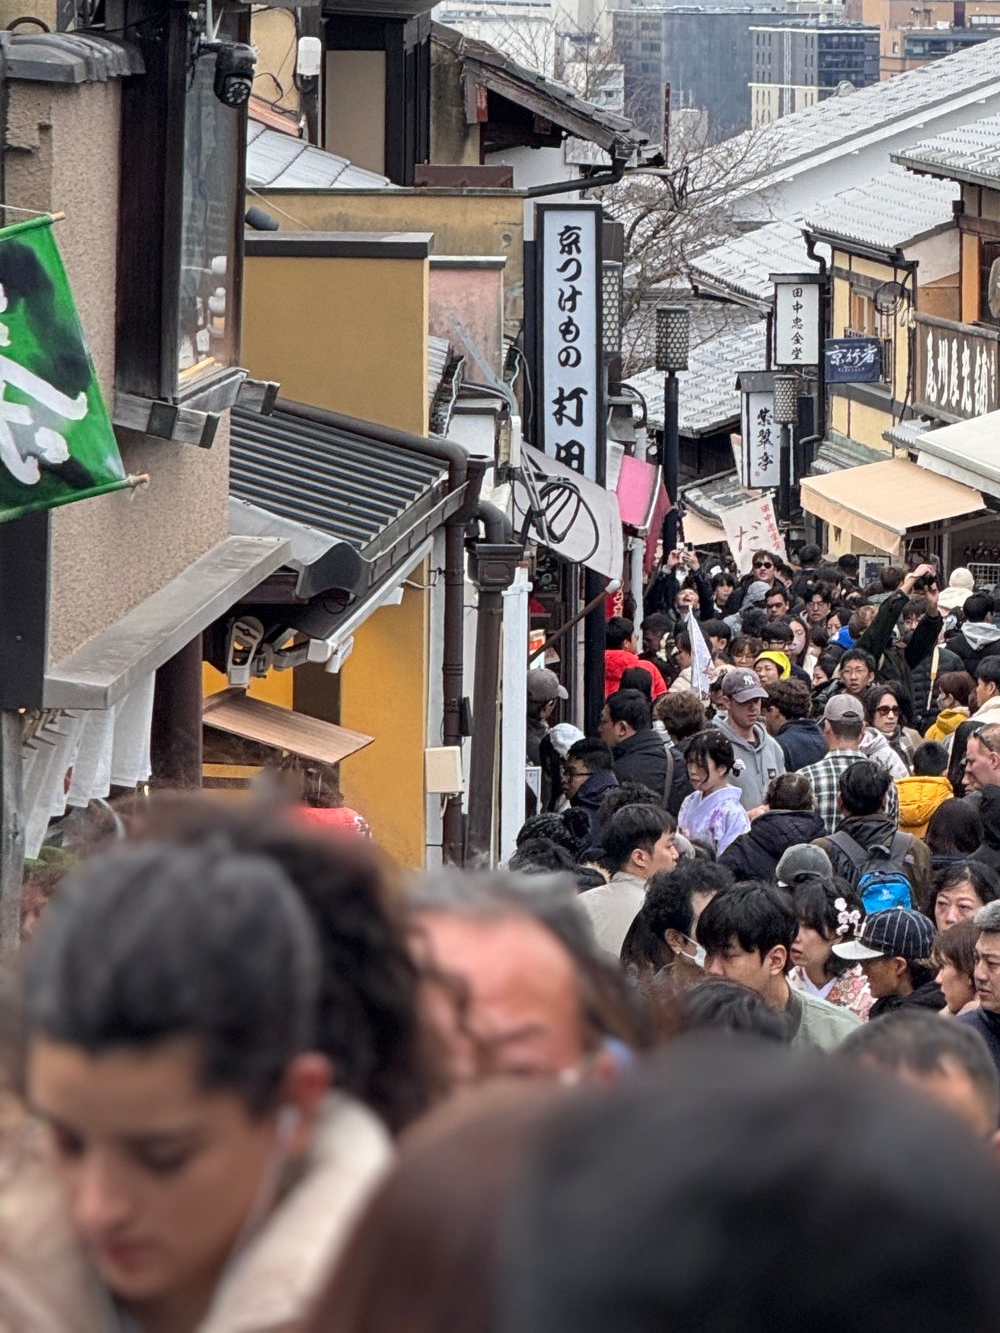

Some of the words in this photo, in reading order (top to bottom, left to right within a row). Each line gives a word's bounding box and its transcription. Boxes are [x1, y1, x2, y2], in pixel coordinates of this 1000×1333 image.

[556, 225, 583, 368] 京つけもの
